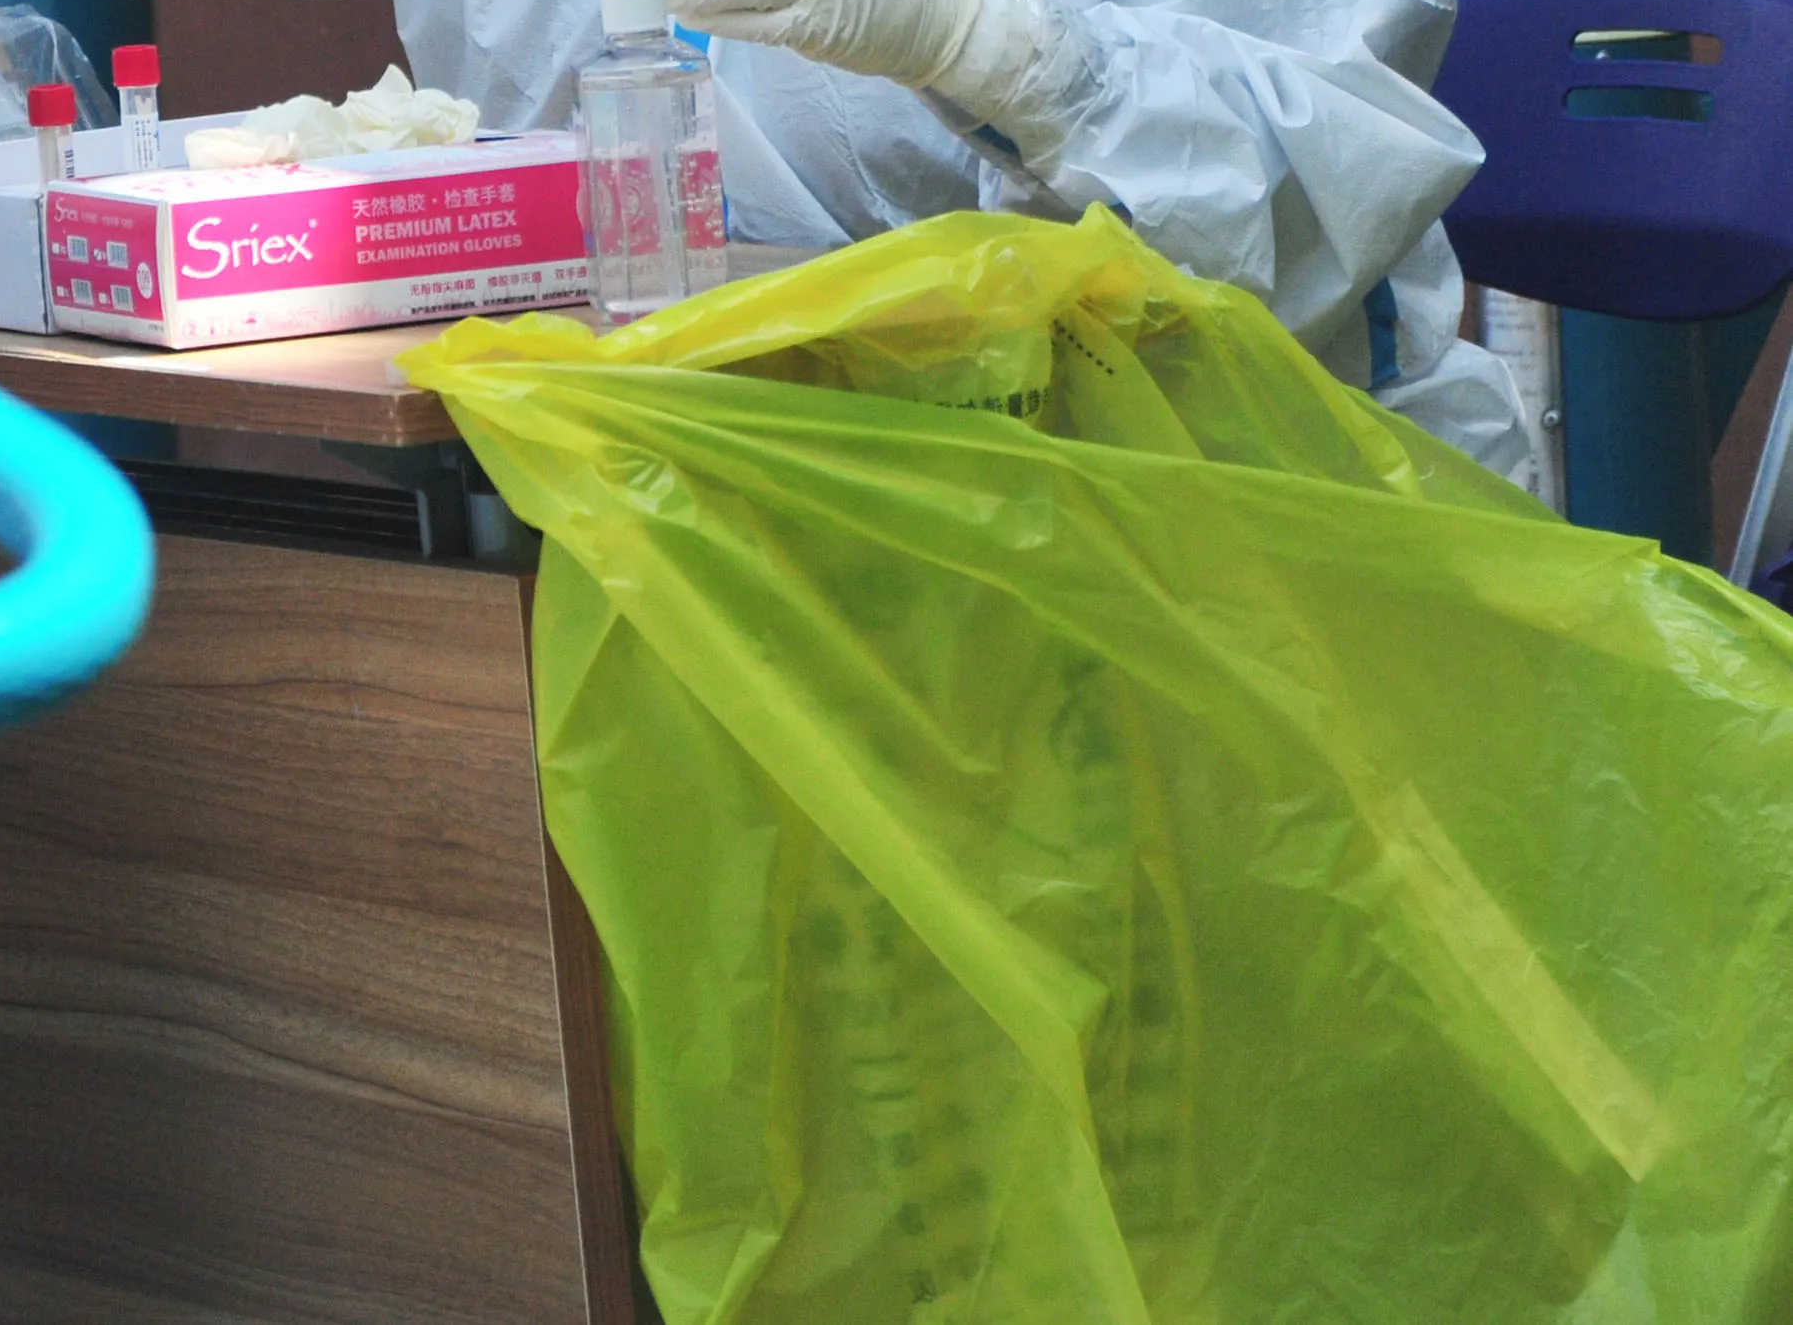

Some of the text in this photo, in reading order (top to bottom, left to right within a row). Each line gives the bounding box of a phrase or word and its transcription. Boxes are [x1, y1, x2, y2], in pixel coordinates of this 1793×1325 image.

[355, 209, 517, 243] PREMIUM LATEX
[180, 216, 314, 280] Sriex
[357, 234, 523, 265] EXAMINATION GLOVES
